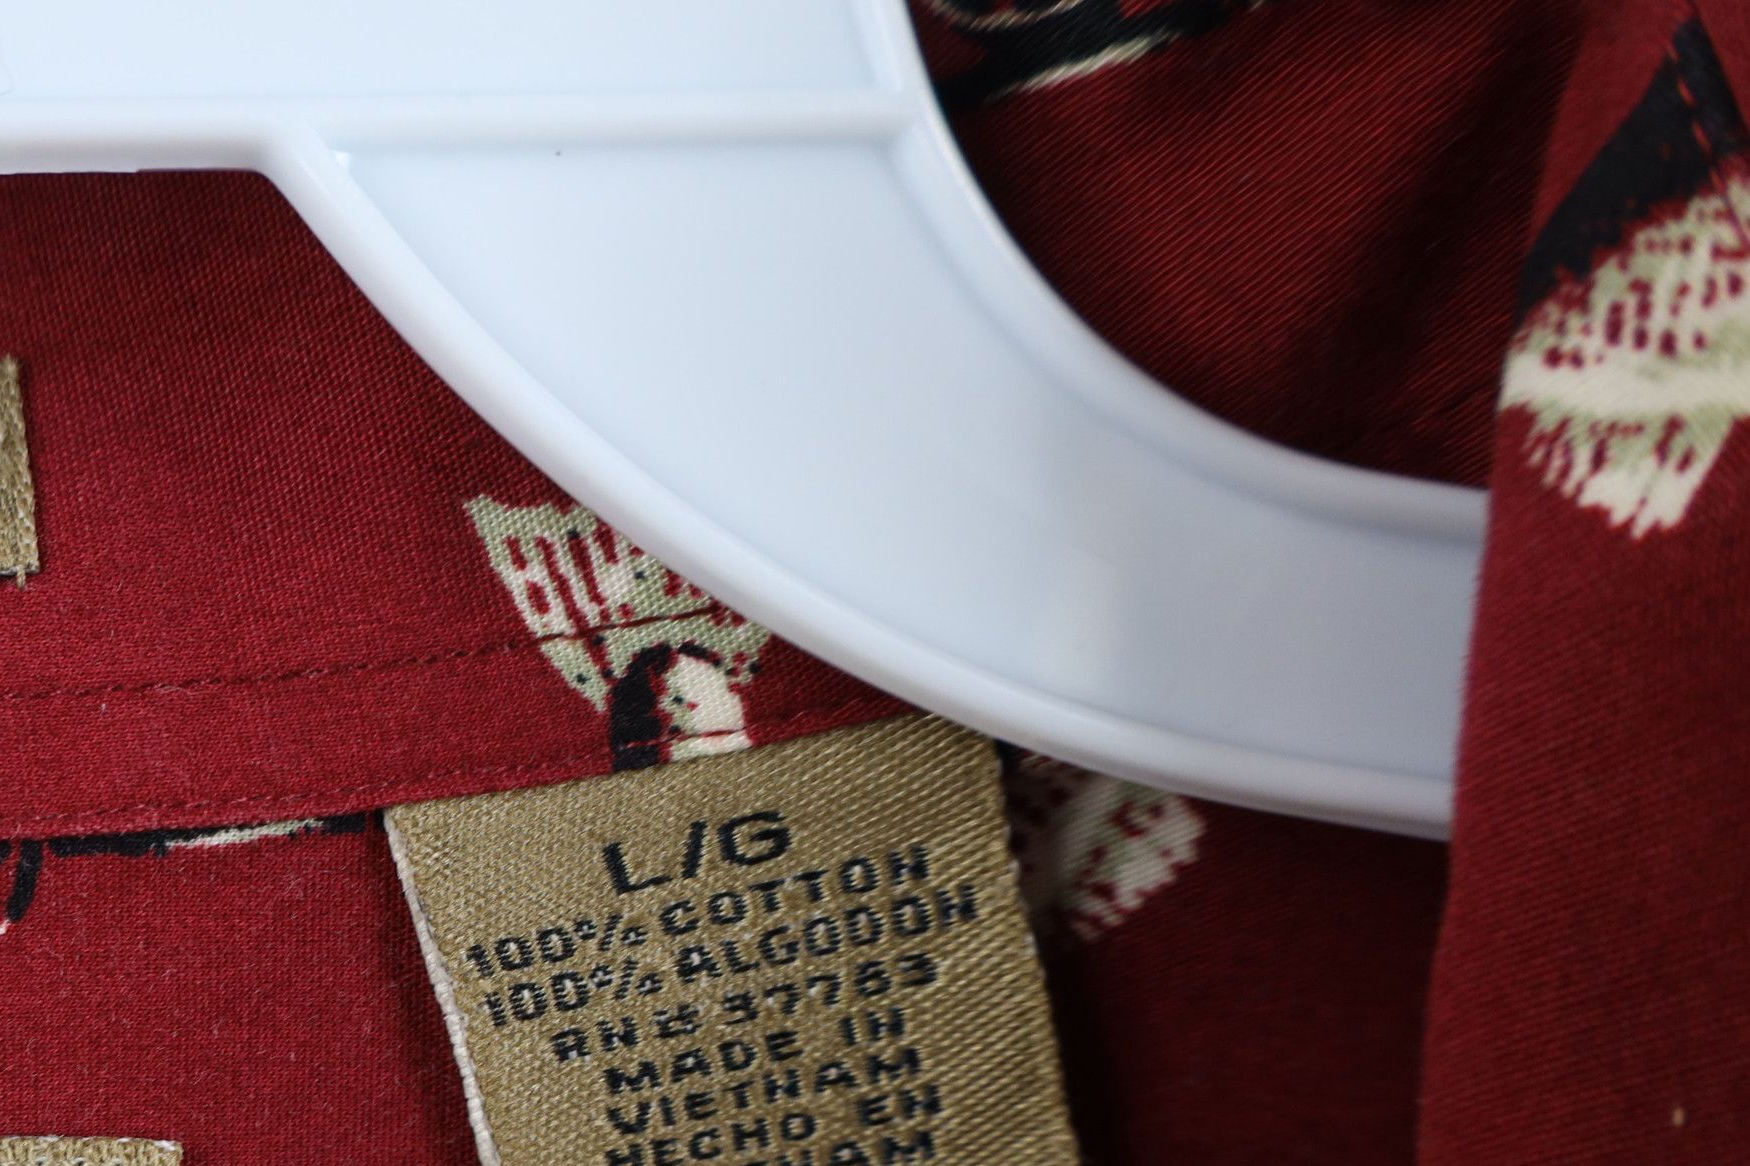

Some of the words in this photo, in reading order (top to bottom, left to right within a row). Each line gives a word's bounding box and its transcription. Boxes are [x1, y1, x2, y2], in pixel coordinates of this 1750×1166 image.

[601, 810, 791, 896] L/G
[465, 912, 648, 979] 100%
[658, 846, 932, 937] COTTON
[483, 956, 662, 1027] 100%
[676, 883, 978, 984] ALGODON
[603, 1031, 803, 1095] MADE
[839, 1006, 905, 1047] IN
[607, 1047, 922, 1135] VIETNAM
[857, 1083, 943, 1127] EN
